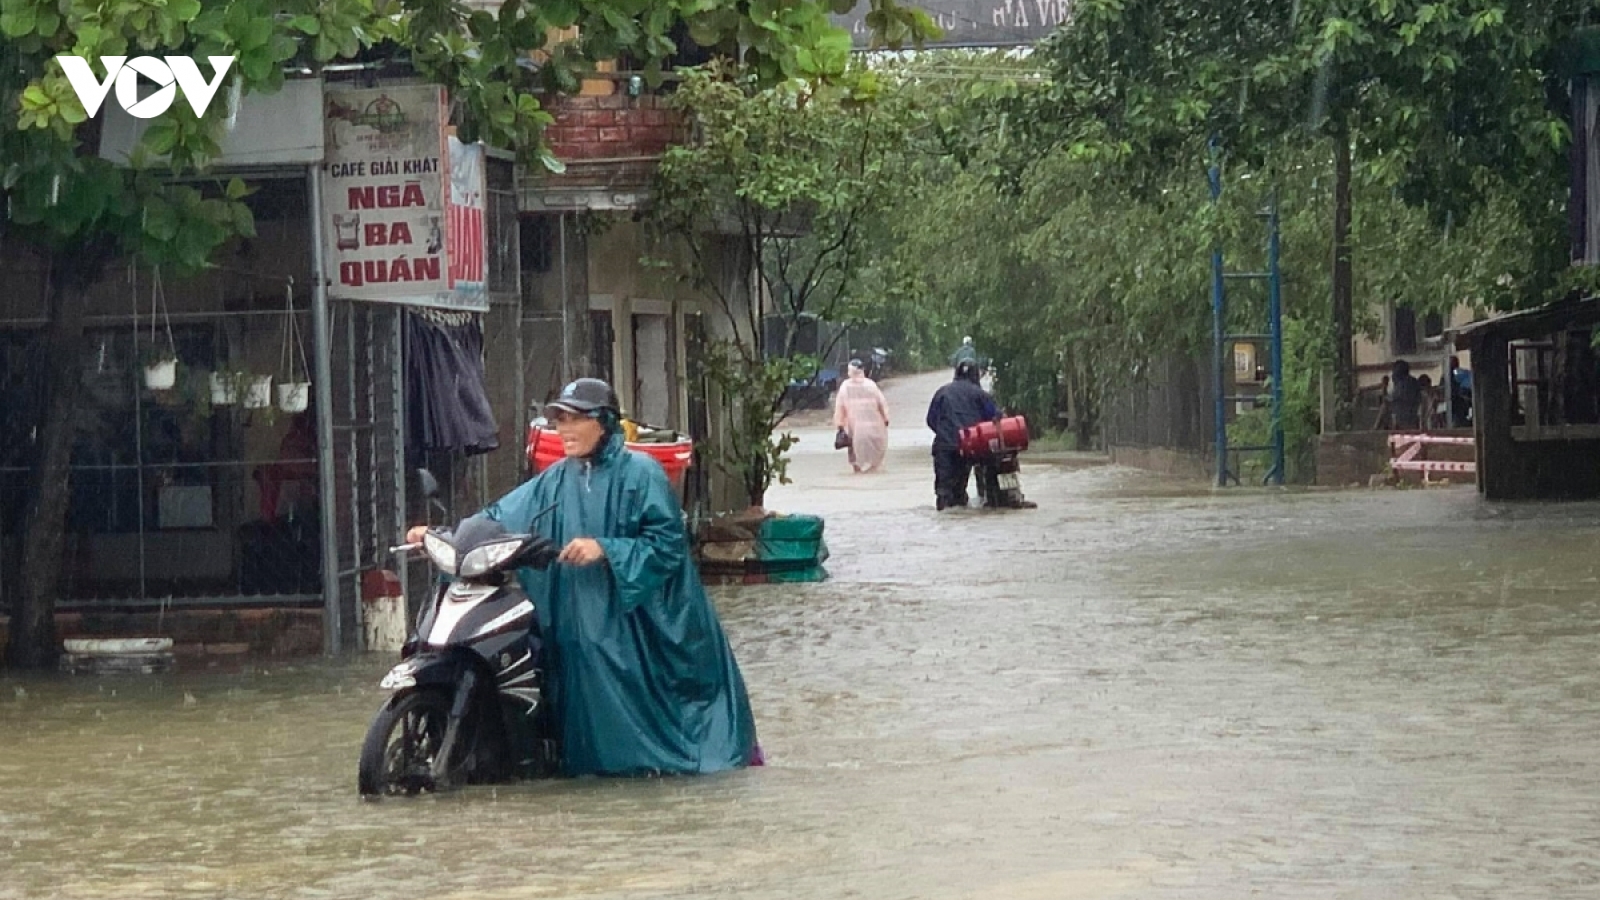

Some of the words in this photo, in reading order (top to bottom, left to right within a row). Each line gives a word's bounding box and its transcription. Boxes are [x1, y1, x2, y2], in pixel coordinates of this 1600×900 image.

[370, 154, 399, 177] GIẢI
[403, 155, 439, 175] KHÁT
[364, 221, 413, 247] BA
[339, 255, 441, 287] QUÁN
